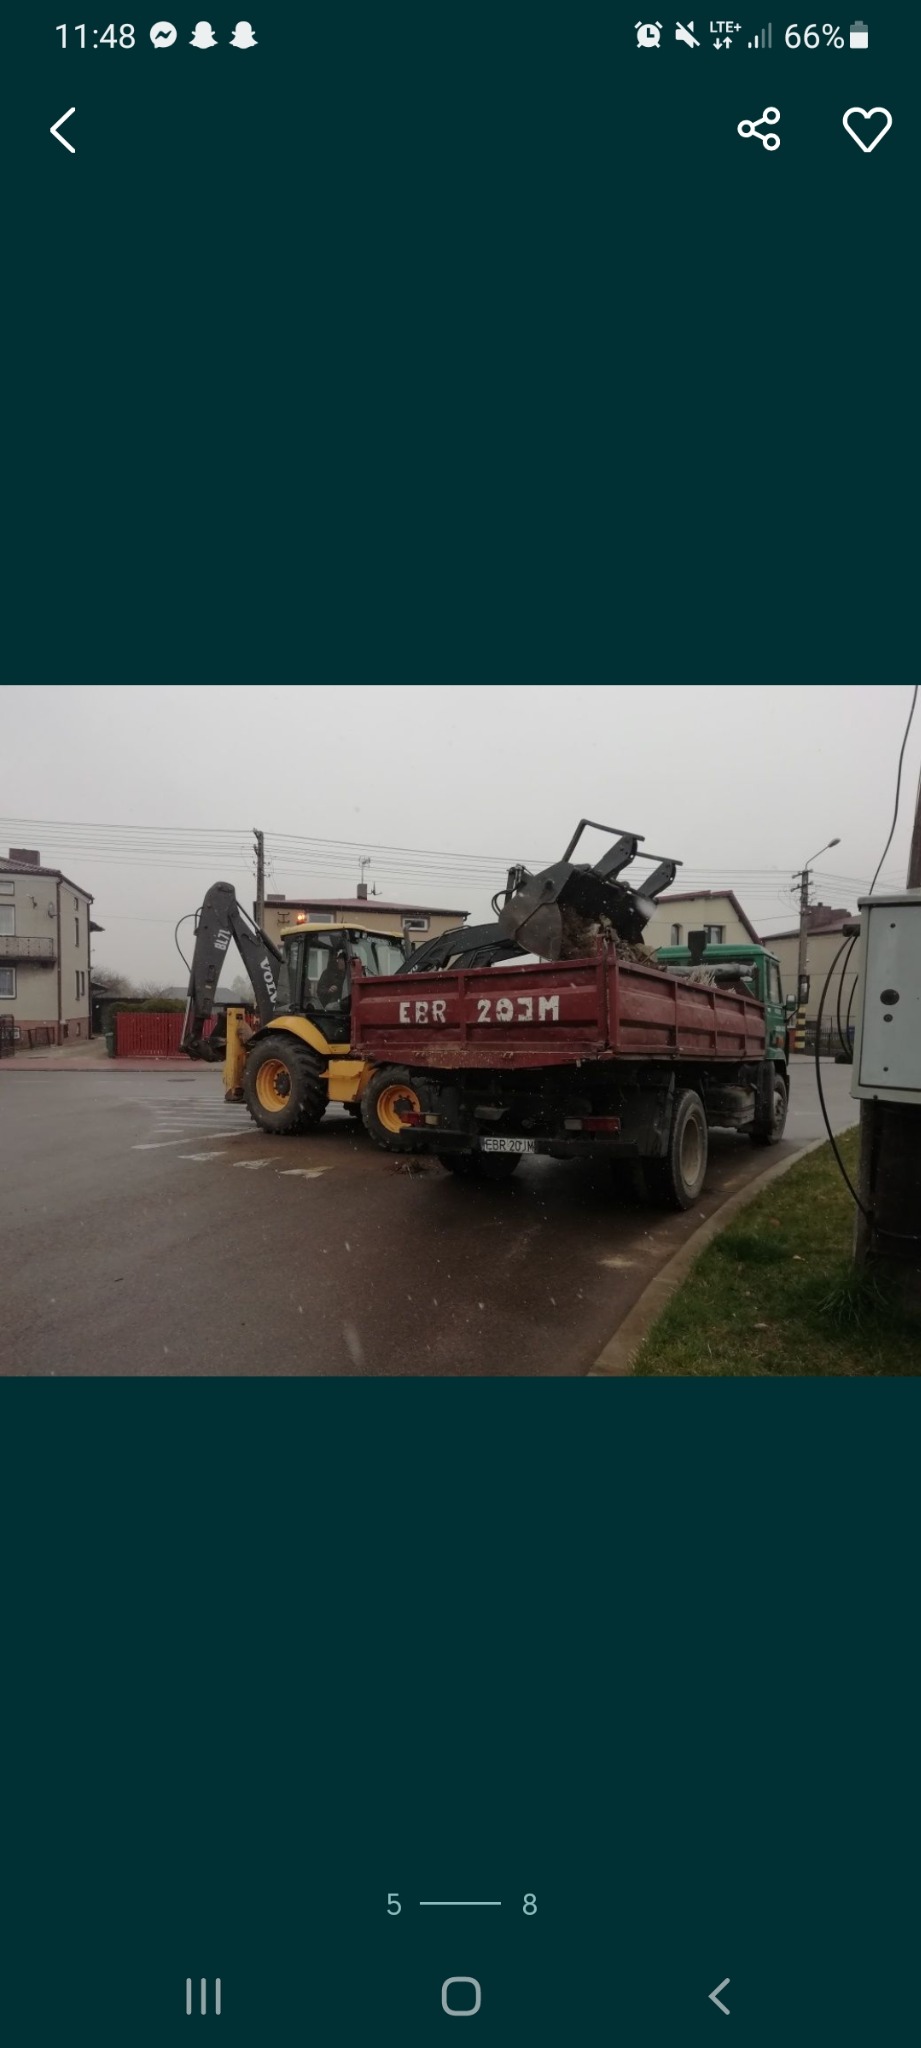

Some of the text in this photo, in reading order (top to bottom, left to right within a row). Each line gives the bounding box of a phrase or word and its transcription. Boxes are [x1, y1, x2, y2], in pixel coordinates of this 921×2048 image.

[213, 929, 231, 950] BL71
[260, 956, 277, 1011] VOLV
[399, 1000, 446, 1024] EBR
[486, 1139, 506, 1151] EBR
